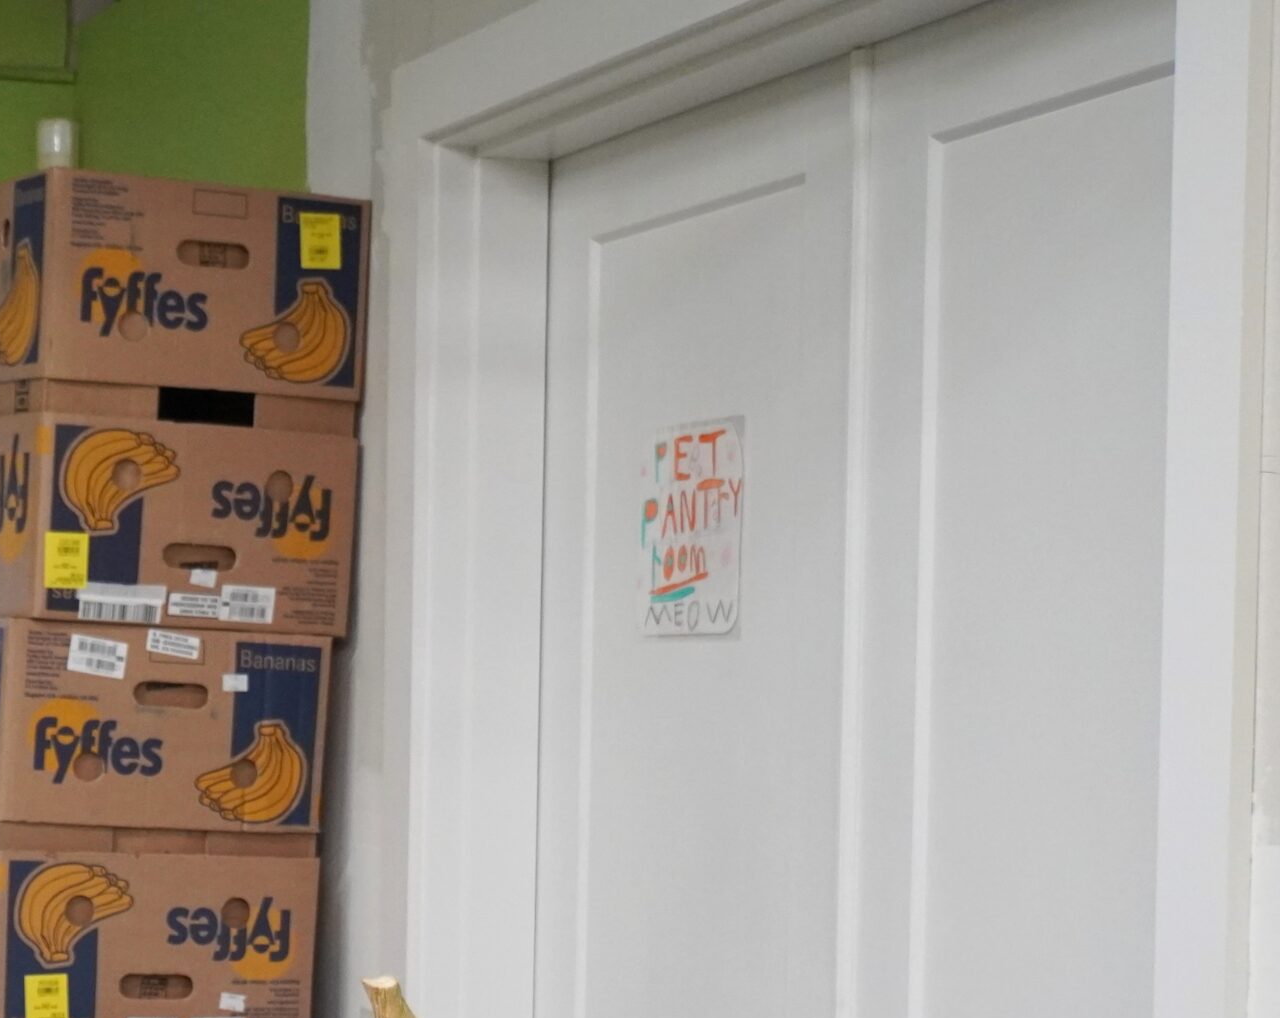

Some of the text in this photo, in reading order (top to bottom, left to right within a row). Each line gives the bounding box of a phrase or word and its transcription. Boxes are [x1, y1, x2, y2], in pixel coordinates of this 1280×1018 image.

[80, 267, 209, 337] fyffes
[655, 429, 727, 482] PET
[211, 474, 333, 541] fyffes
[644, 600, 734, 633] MEOW
[239, 649, 316, 673] Bananas
[33, 716, 163, 784] fyffes
[167, 897, 291, 962] fyffes
